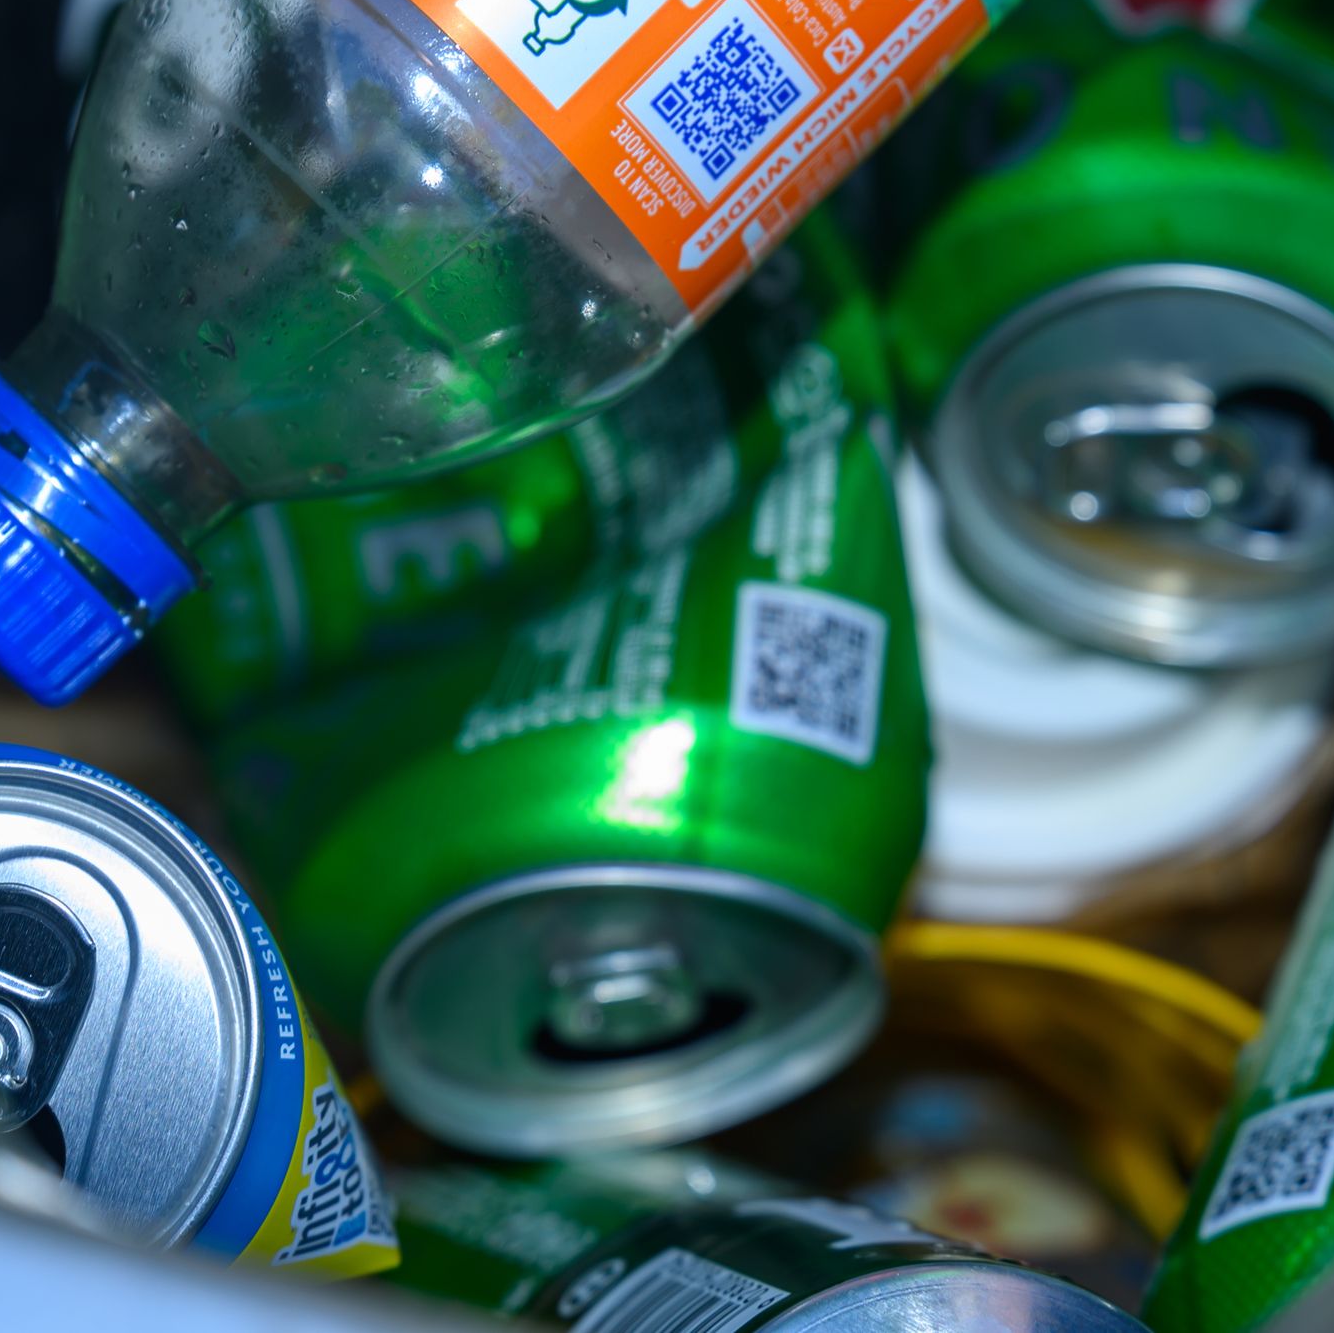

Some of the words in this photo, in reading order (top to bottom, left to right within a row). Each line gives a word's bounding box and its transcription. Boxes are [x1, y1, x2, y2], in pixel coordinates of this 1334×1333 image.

[608, 117, 652, 165] MORE
[790, 84, 860, 155] MICH
[610, 157, 638, 186] TO
[625, 174, 666, 217] SCAN
[639, 154, 699, 219] DISCOVER
[691, 152, 794, 254] WIEDER
[192, 839, 251, 916] YOUR
[251, 925, 295, 1058] REFRESH
